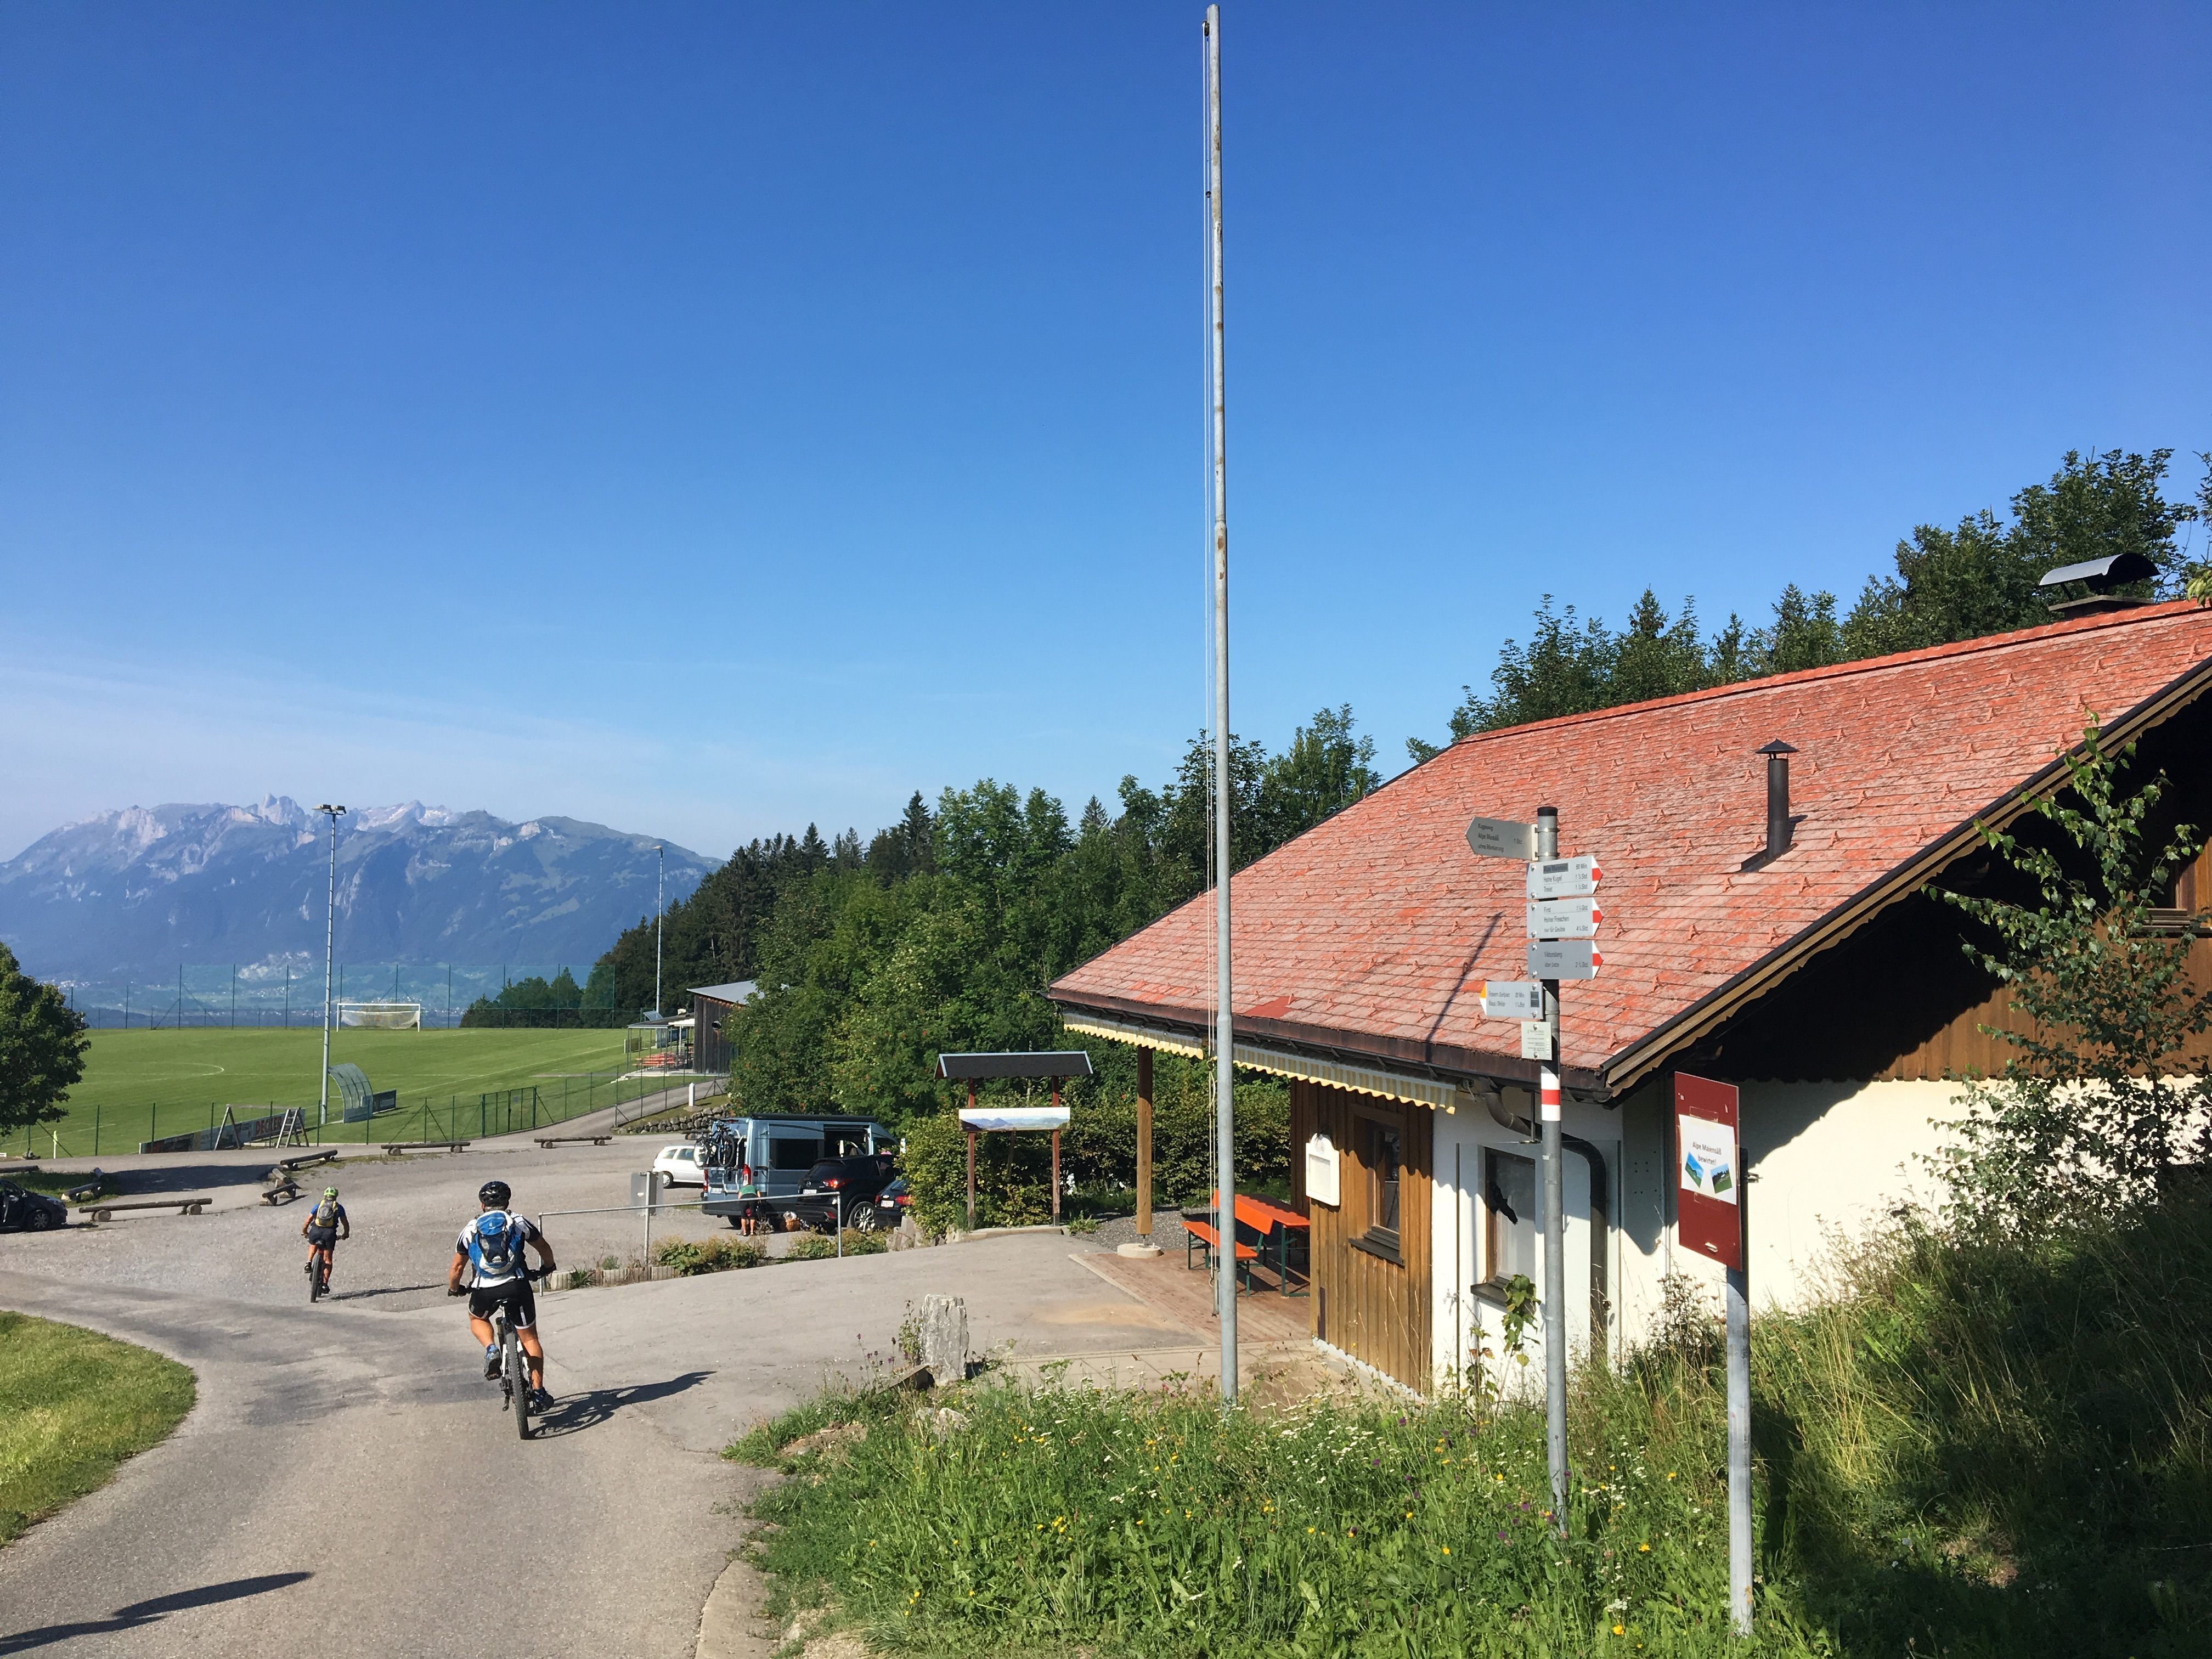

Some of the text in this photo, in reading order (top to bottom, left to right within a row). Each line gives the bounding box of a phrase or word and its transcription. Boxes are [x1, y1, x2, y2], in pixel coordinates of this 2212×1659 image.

[1553, 875, 1562, 883] Kugel
[1692, 1141, 1722, 1155] Alpe Maiensäß
[1698, 1154, 1717, 1166] bewirtet!
